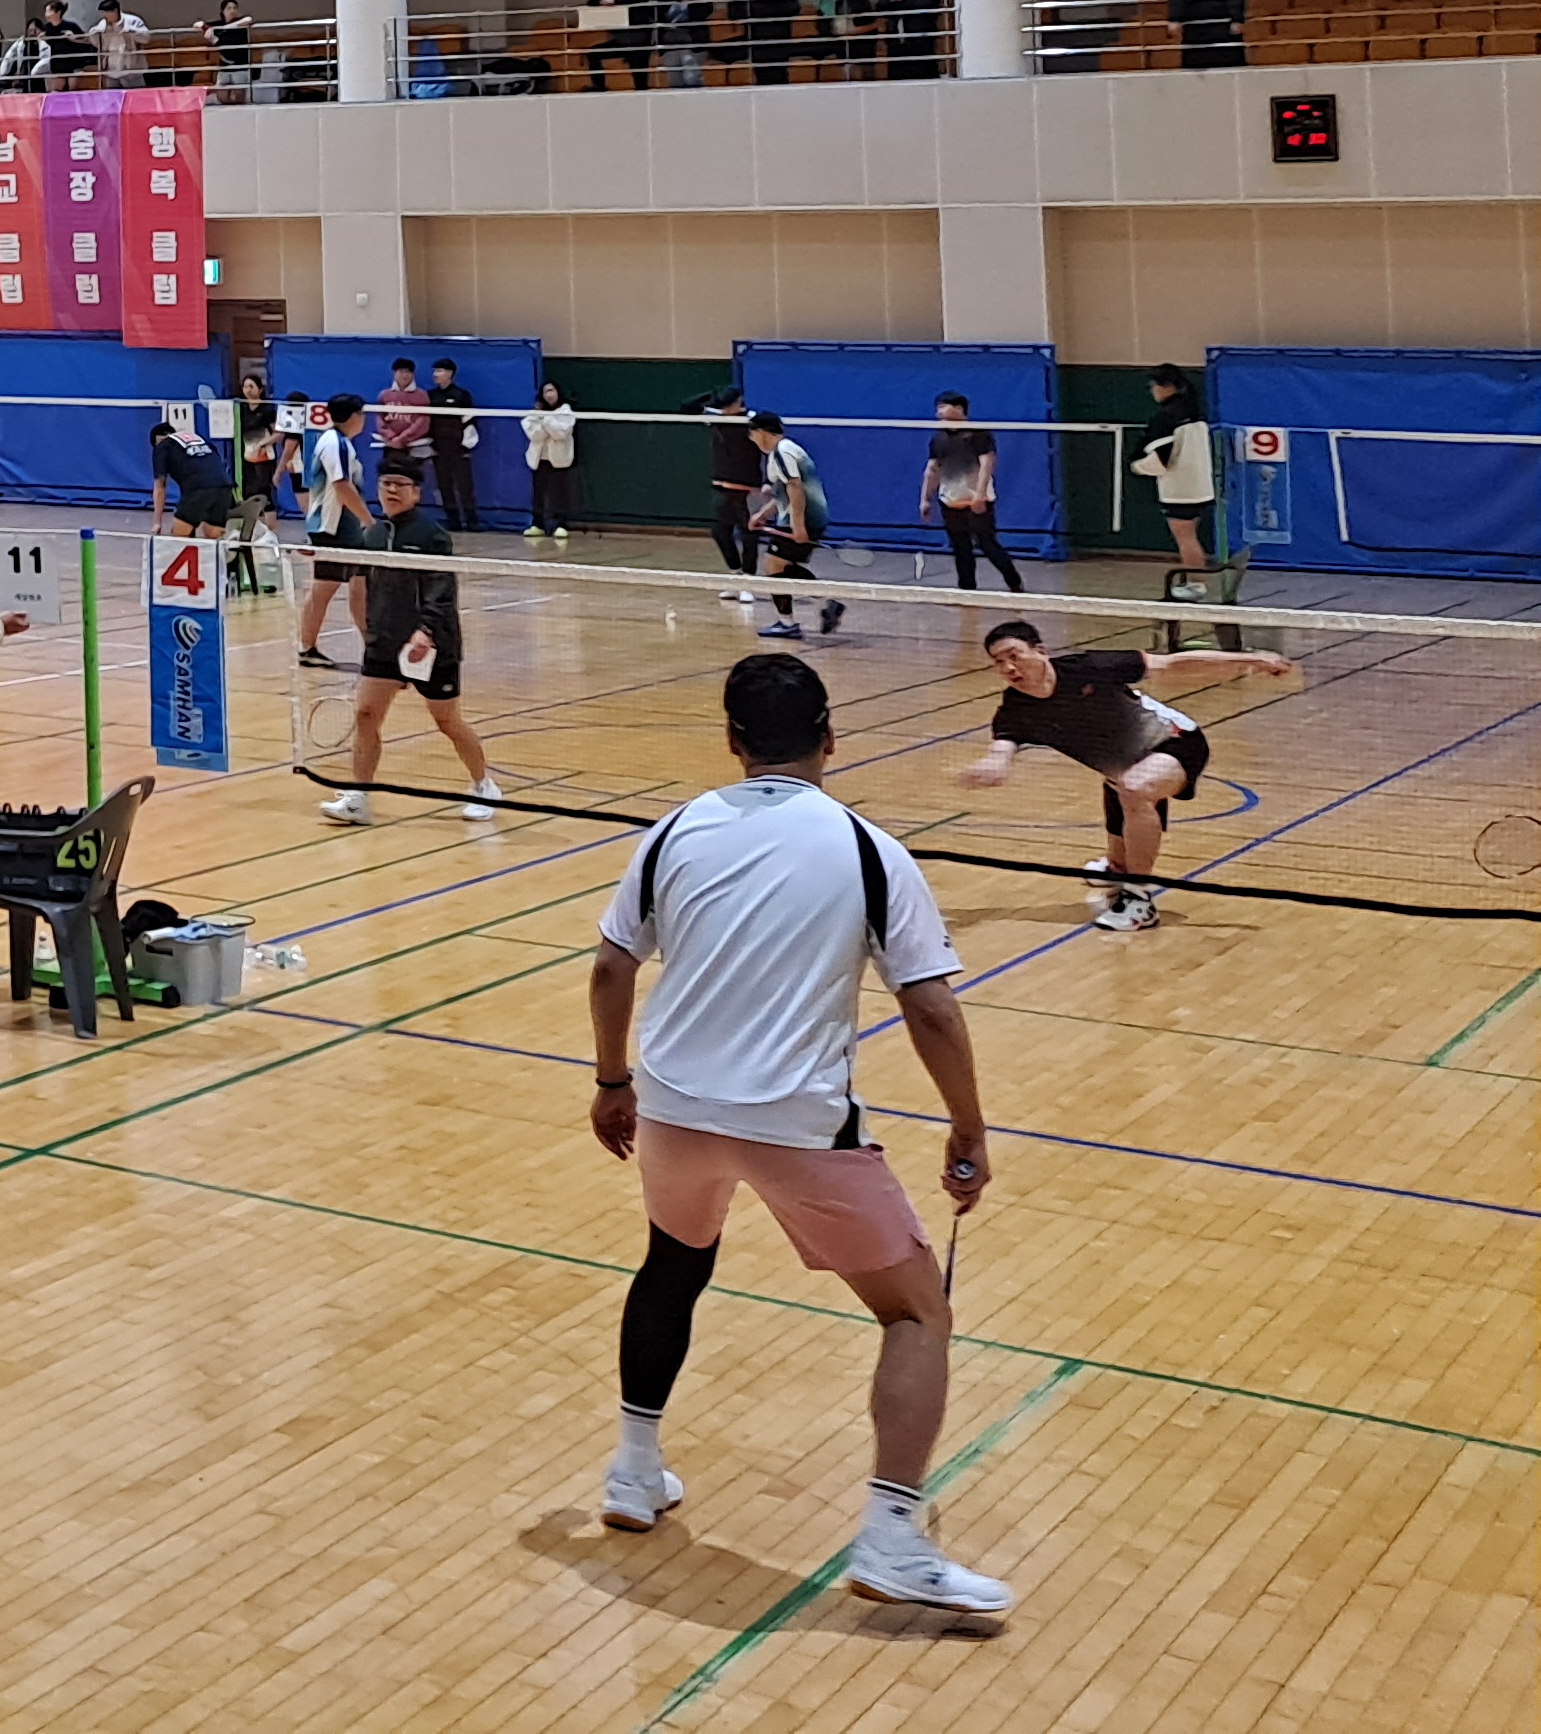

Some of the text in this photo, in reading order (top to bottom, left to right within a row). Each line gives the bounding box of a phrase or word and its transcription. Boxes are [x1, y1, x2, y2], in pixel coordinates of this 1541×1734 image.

[148, 125, 176, 200] 행복
[173, 408, 187, 420] 11
[309, 405, 328, 426] 8
[1252, 431, 1279, 456] 9
[8, 546, 42, 574] 11
[160, 545, 205, 596] 4
[175, 652, 193, 741] SAMHAN
[56, 826, 97, 870] 25
